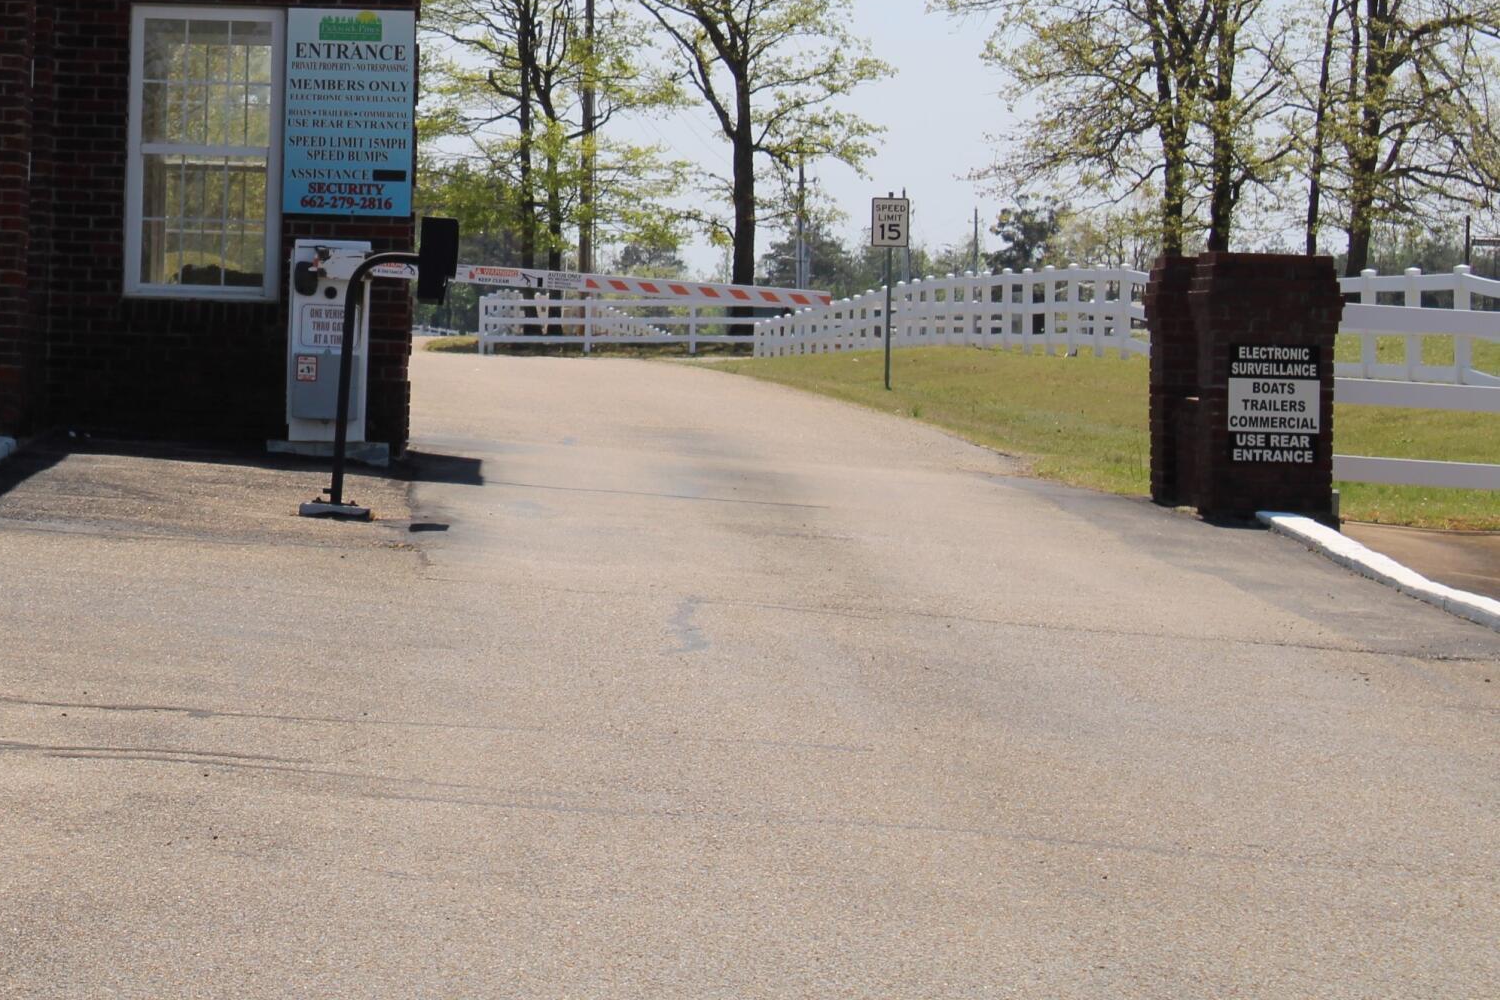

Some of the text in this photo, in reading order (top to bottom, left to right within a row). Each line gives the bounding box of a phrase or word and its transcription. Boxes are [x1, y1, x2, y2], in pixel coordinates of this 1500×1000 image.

[295, 42, 406, 61] ENTRANCE
[291, 61, 409, 73] PRIVATE PROPERTY NO TRESPASSING
[290, 78, 409, 93] MEMBERS ONLY
[290, 93, 408, 103] ELECTRONIC SURVEILLANCE
[359, 111, 407, 119] COMMERCIAL
[287, 118, 410, 131] USE REAR ENTRANCE
[288, 136, 327, 147] SPEED
[330, 137, 364, 148] LIMIT
[306, 150, 389, 162] SPEED BUMPS
[290, 168, 370, 180] ASSISTANCE
[307, 182, 386, 195] SECURITY
[301, 195, 393, 210] 662-279-2816
[875, 204, 906, 212] SPEED
[878, 213, 903, 222] LIMIT
[879, 223, 901, 240] 15
[325, 309, 345, 320] VEHIC
[330, 334, 342, 345] TIM
[1238, 346, 1310, 361] ELECTRONIC
[1231, 362, 1318, 377] SURVEILLANCE
[1252, 382, 1296, 395] BOATS
[1242, 399, 1306, 412] TRAILERS
[1229, 415, 1318, 430] COMMERCIAL
[1236, 433, 1310, 448] USE REAR
[1233, 448, 1314, 463] ENTRANCE
